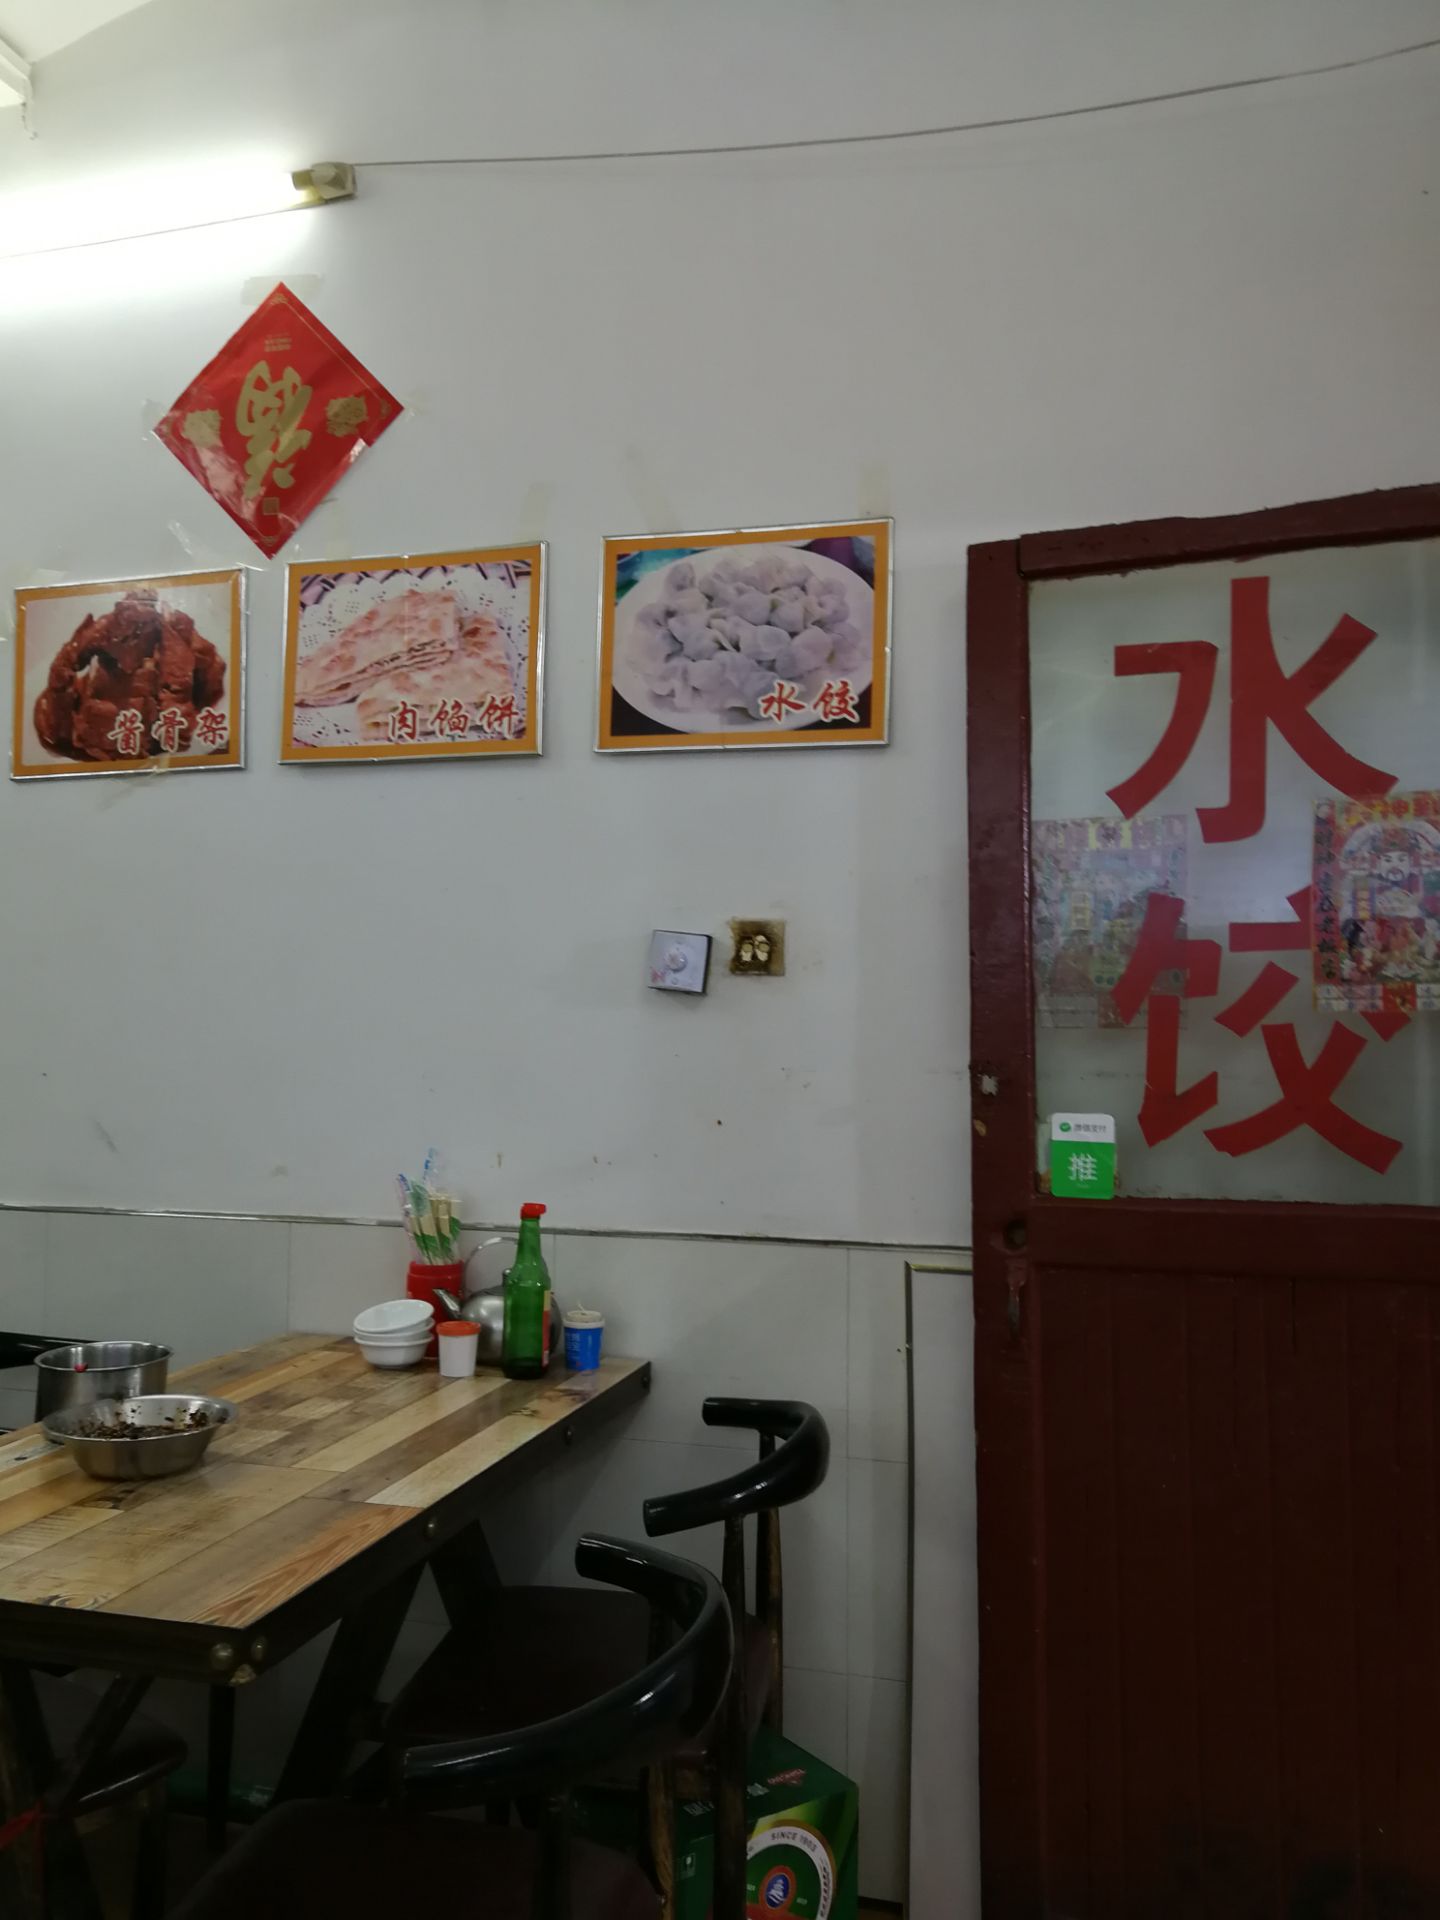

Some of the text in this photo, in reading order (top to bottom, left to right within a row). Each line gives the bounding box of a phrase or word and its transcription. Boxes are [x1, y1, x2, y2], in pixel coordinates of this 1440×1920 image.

[390, 694, 520, 741] 肉馅饼
[759, 678, 858, 722] 水饺
[106, 706, 229, 755] 酱骨架
[1105, 575, 1411, 1175] 水饺
[1067, 1151, 1098, 1182] 推
[771, 1831, 798, 1841] SINCE
